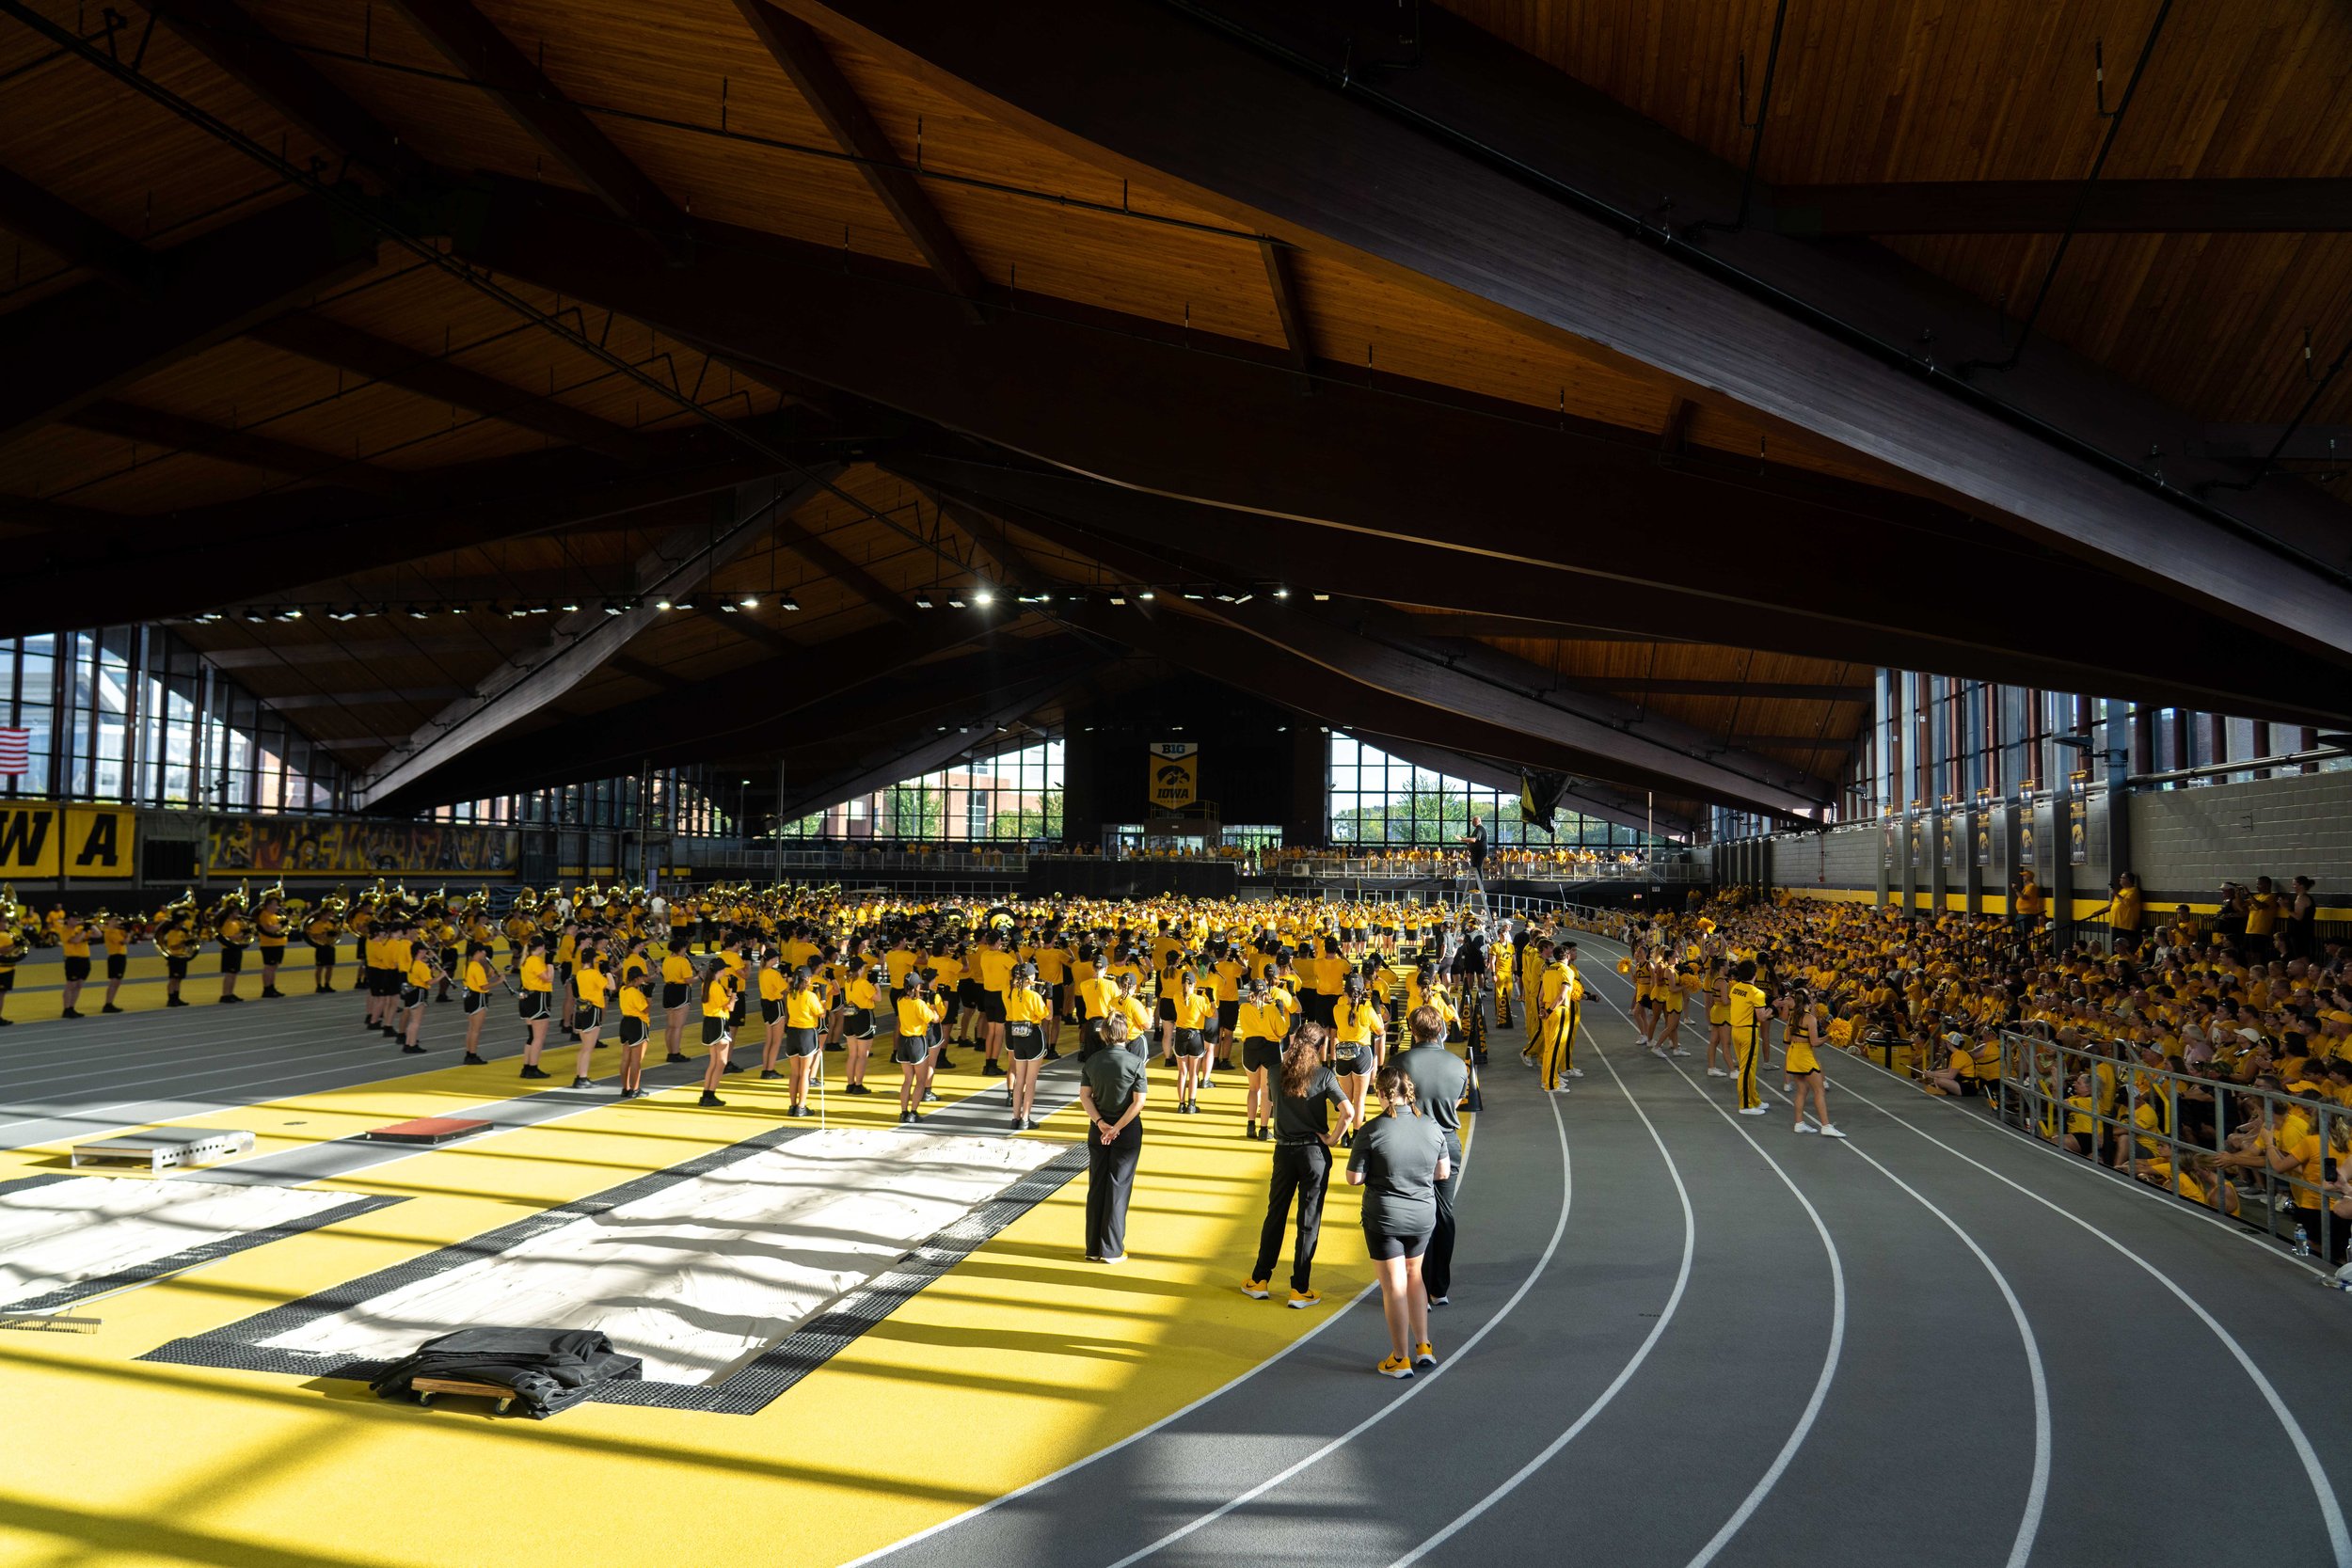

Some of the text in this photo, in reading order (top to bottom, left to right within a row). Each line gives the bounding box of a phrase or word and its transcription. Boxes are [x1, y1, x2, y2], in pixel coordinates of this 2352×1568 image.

[1157, 788, 1189, 799] IOWA
[1732, 988, 1748, 997] IOWA
[1462, 1004, 1471, 1037] IOWA
[1497, 994, 1507, 1025] IOWA
[1476, 1013, 1487, 1053] IOWA
